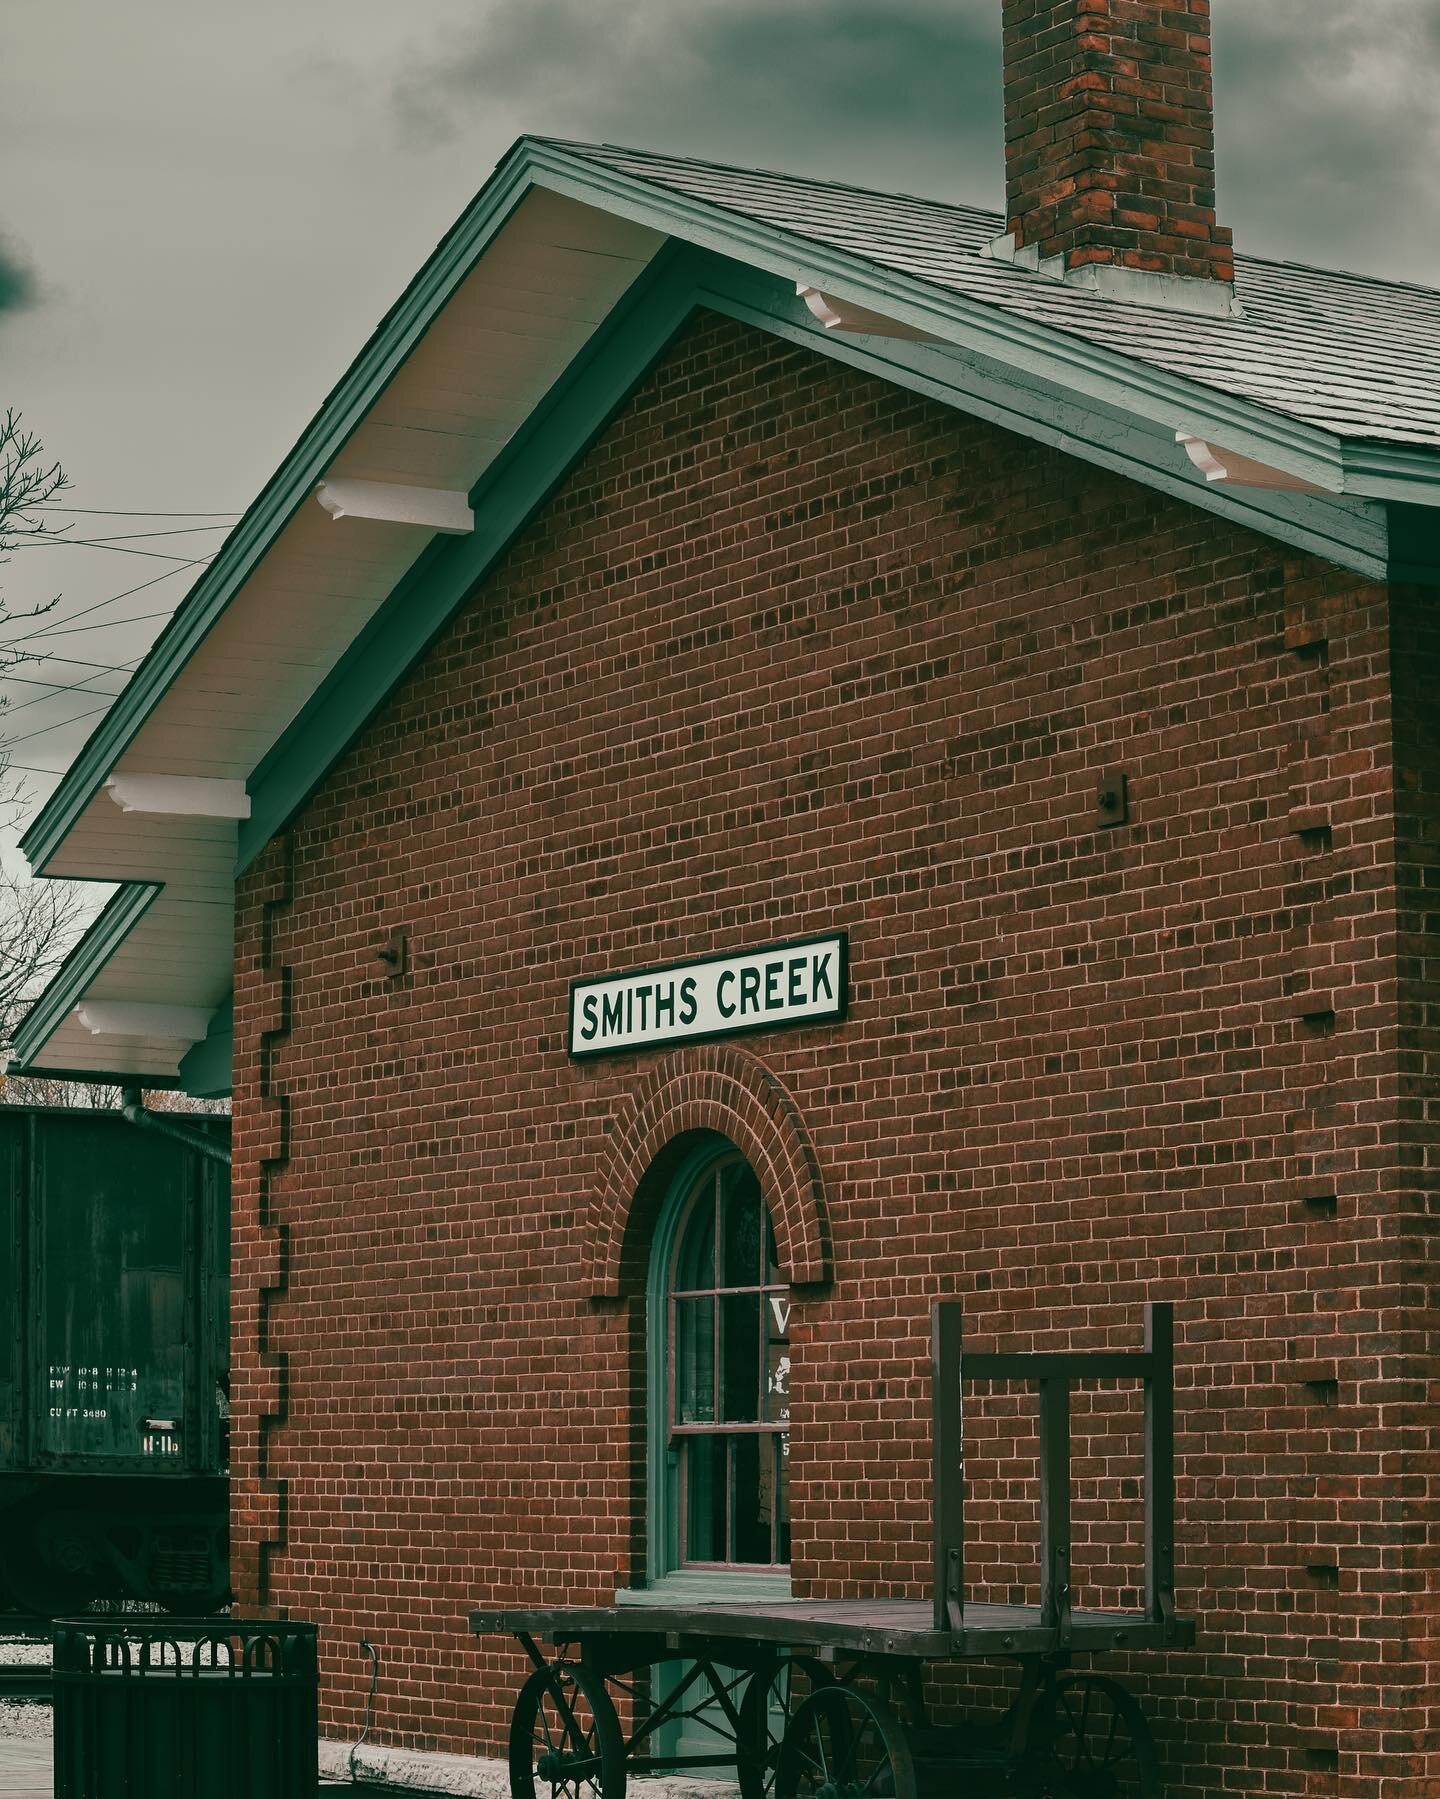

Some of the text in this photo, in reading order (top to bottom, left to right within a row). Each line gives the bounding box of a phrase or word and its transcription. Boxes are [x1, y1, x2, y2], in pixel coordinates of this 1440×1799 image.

[580, 953, 833, 1041] SMITHS CREEK
[49, 1379, 64, 1389] EW
[49, 1407, 62, 1417] CU
[66, 1408, 78, 1418] FT
